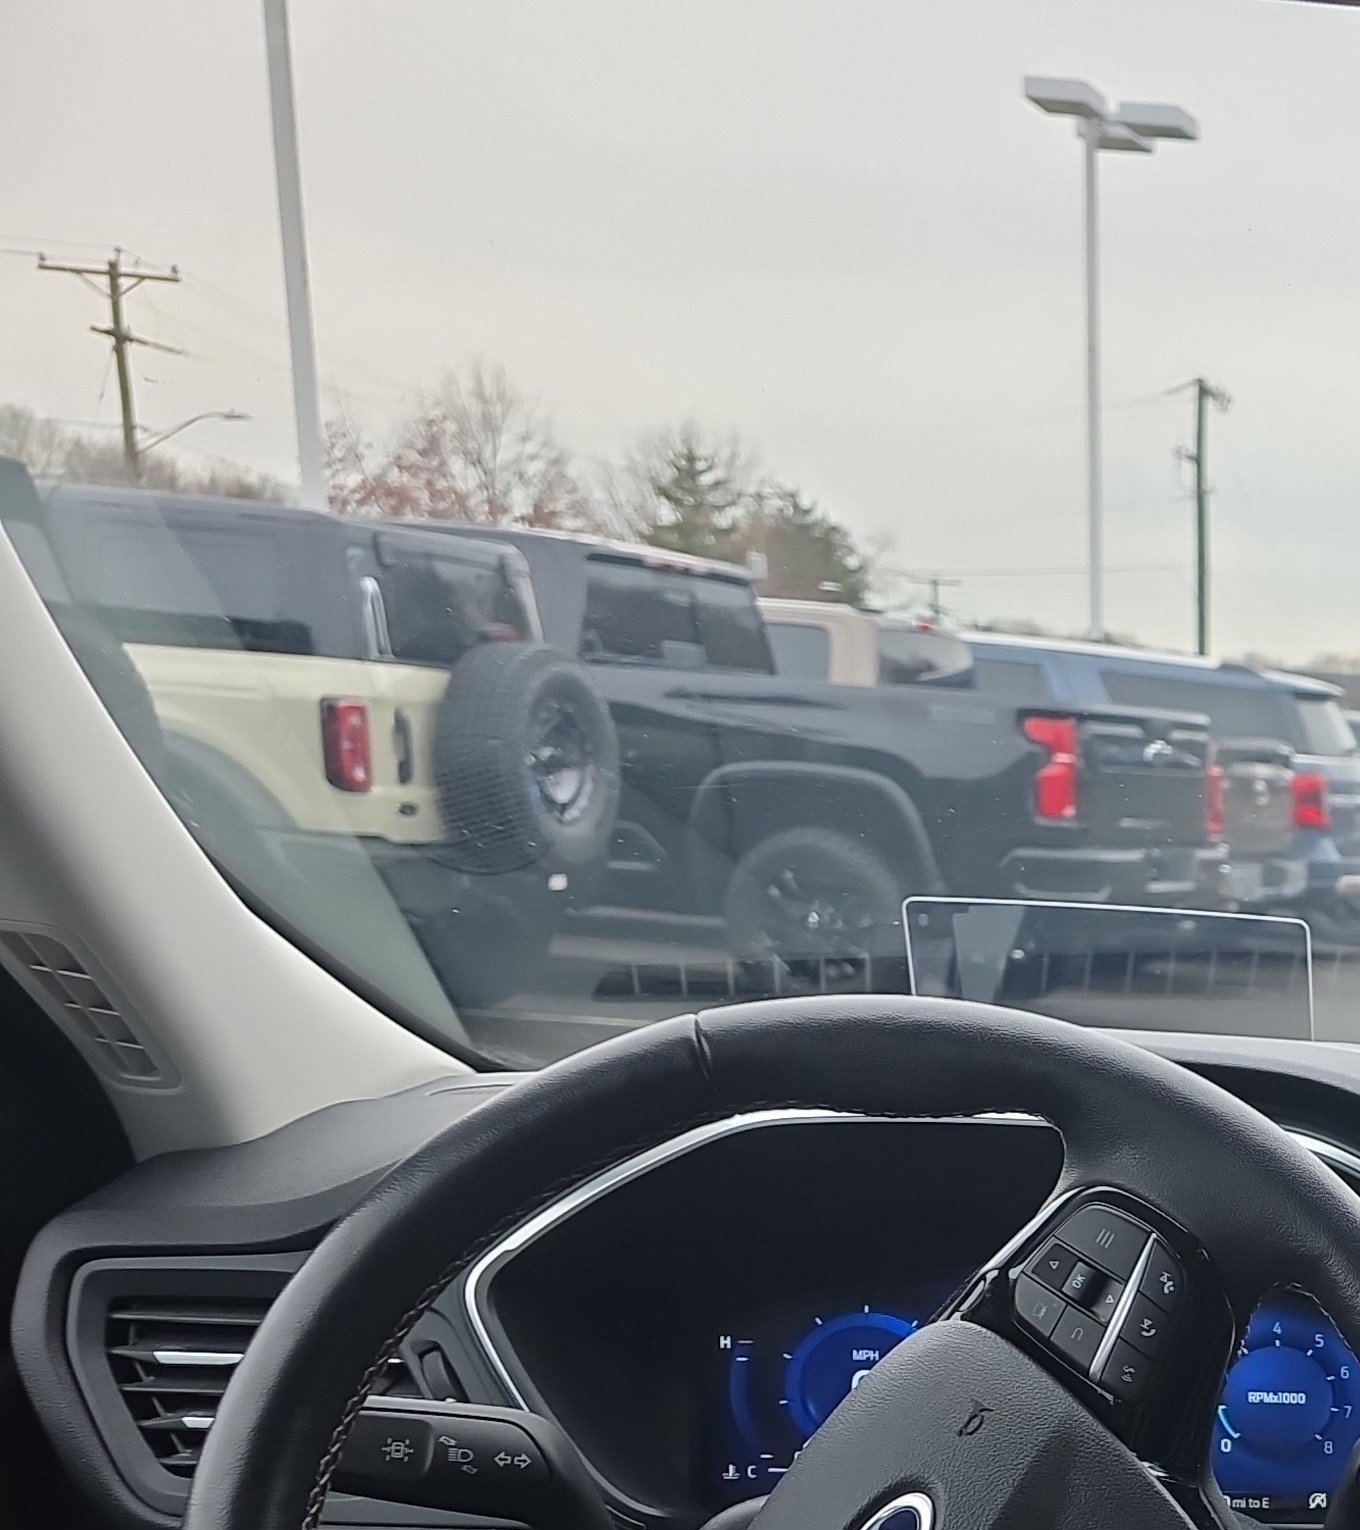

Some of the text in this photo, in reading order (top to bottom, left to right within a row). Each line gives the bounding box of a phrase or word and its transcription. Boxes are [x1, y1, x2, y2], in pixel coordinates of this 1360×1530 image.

[1071, 1273, 1087, 1289] OK
[1272, 1321, 1283, 1335] 4
[719, 1335, 732, 1349] H
[1315, 1333, 1325, 1348] 5
[852, 1349, 880, 1362] MPH
[1339, 1365, 1350, 1380] 6
[1247, 1391, 1307, 1405] RPMx1000
[1343, 1405, 1353, 1419] 7
[1219, 1438, 1232, 1453] 0
[1323, 1440, 1334, 1455] 8
[746, 1465, 758, 1478] C
[1231, 1496, 1248, 1508] mi
[1248, 1496, 1261, 1508] to
[1261, 1497, 1270, 1509] E
